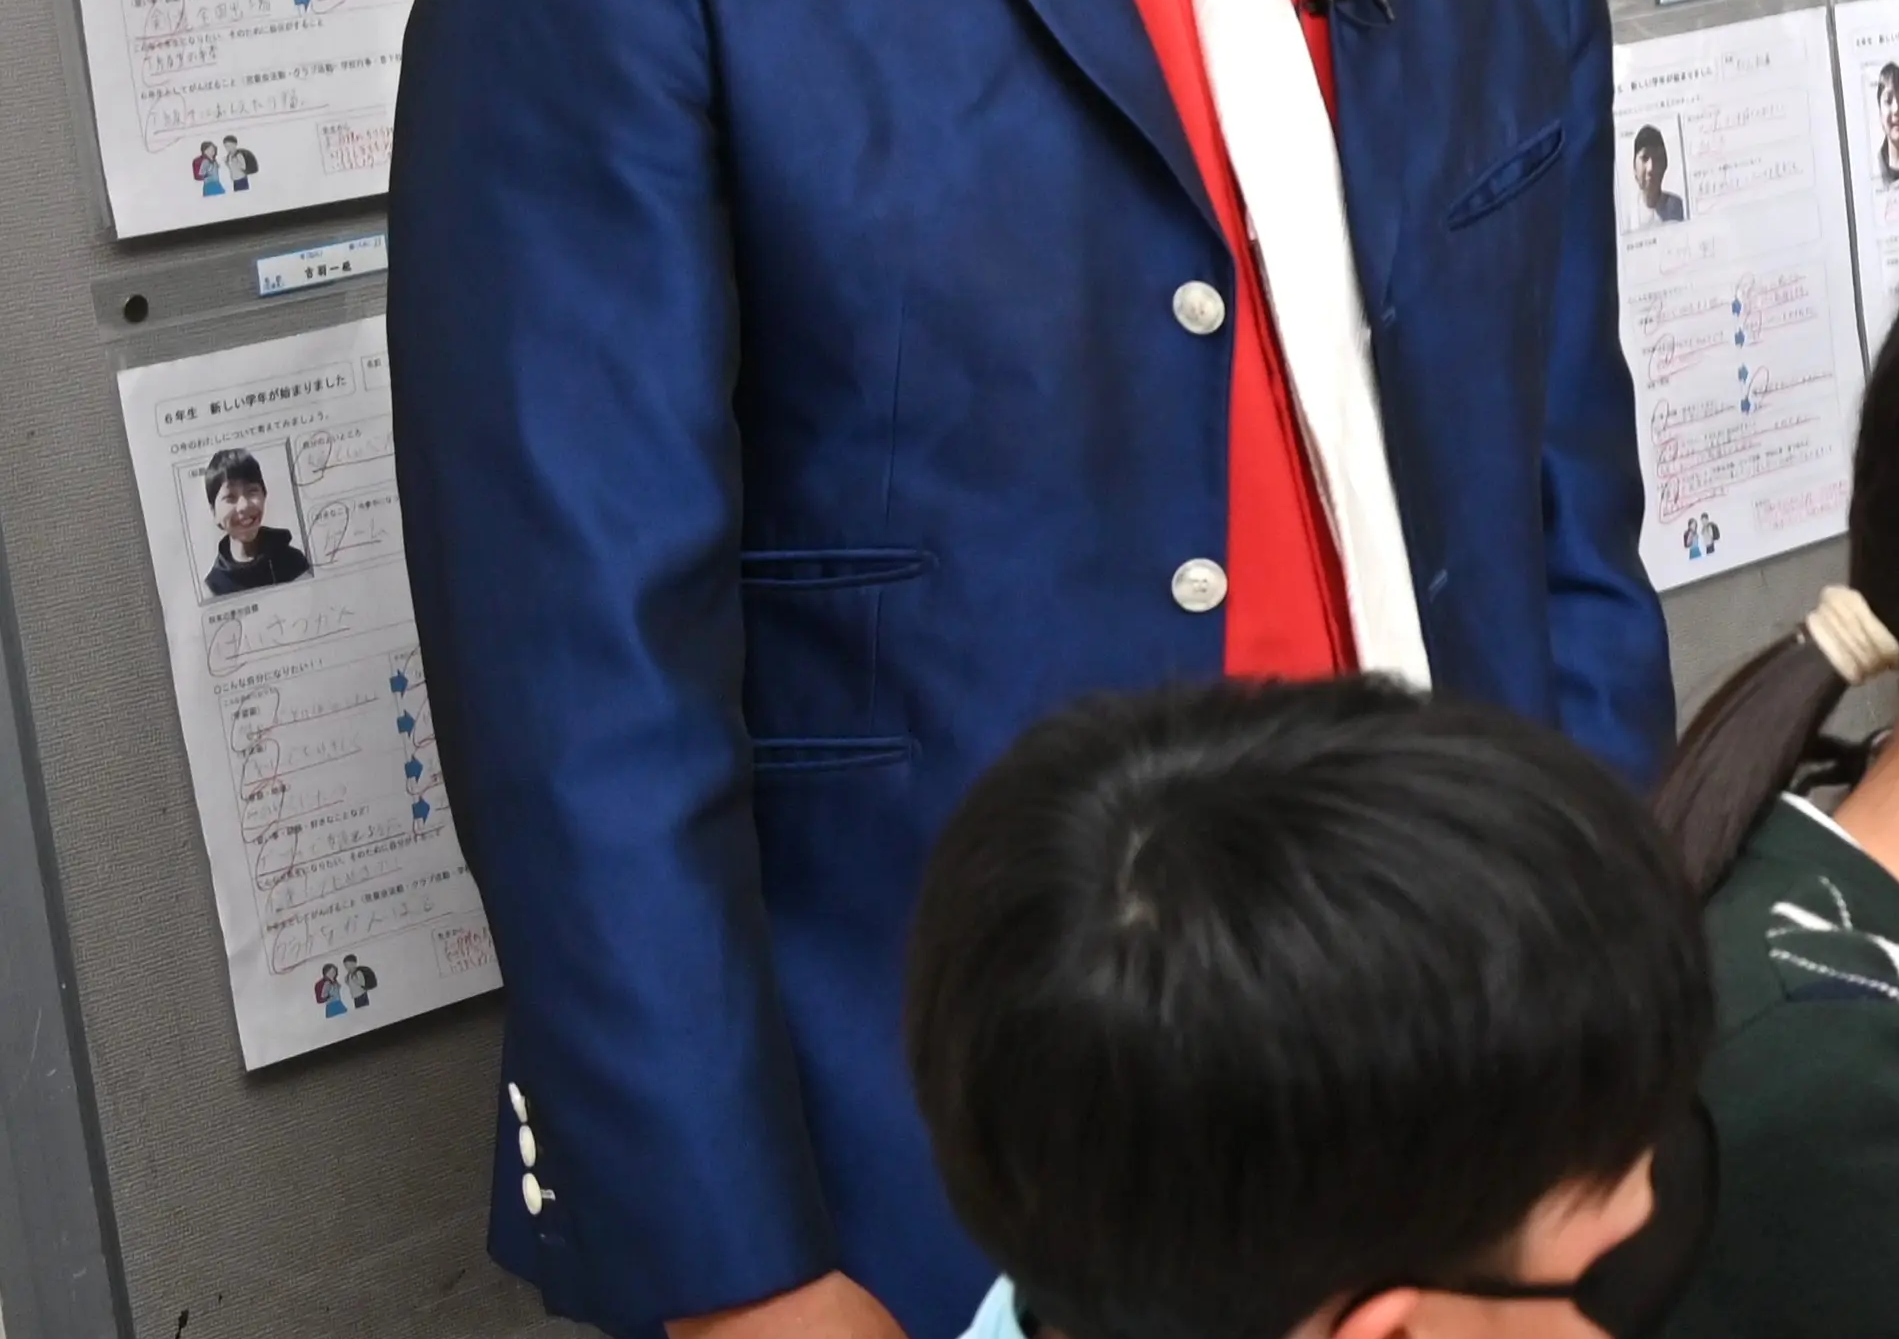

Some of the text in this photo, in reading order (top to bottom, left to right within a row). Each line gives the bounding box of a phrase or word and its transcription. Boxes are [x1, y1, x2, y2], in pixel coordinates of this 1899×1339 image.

[164, 373, 347, 426] 6年生 新しい学年が始まりました
